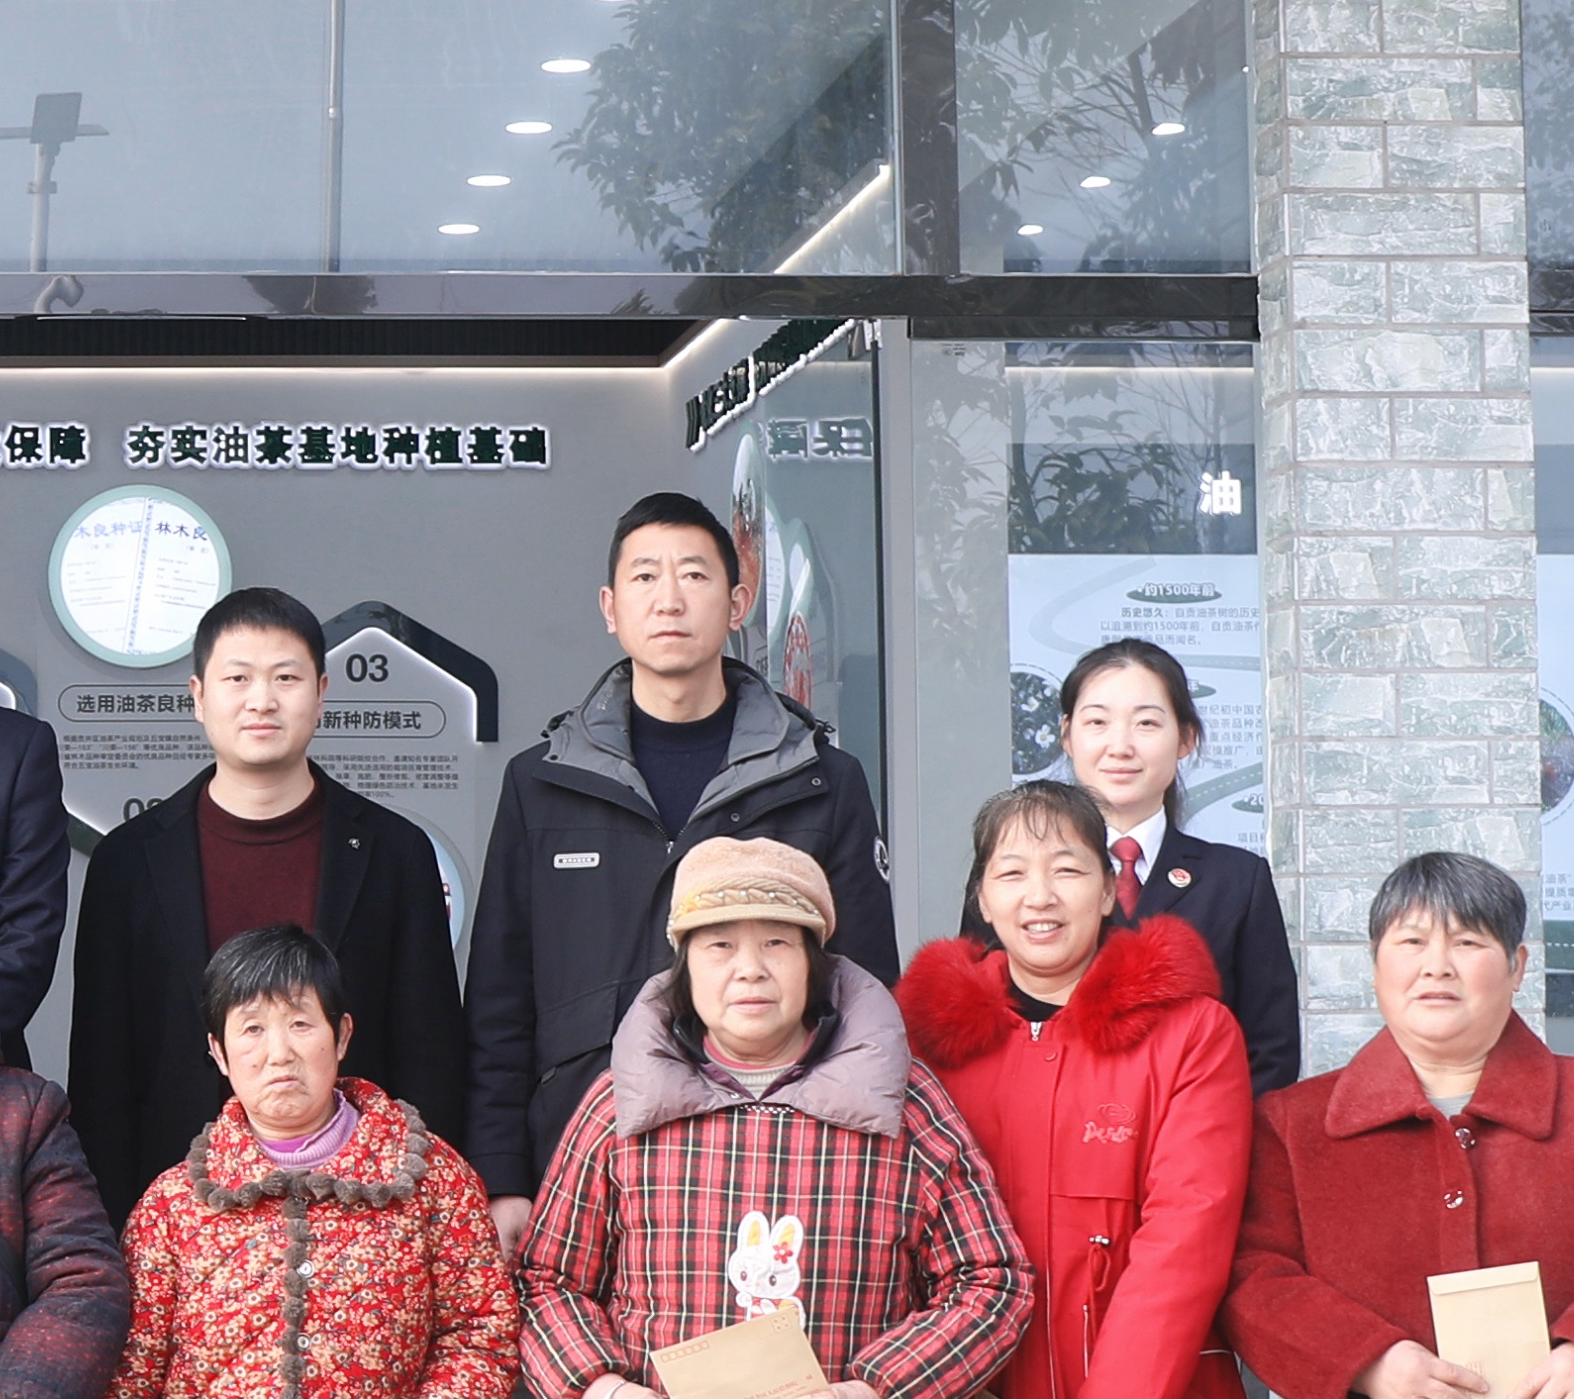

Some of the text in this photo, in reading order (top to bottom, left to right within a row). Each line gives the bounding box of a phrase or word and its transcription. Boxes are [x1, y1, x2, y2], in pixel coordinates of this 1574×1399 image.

[126, 420, 549, 469] 夯实油茶基地种植基础
[1199, 470, 1242, 516] 油
[1143, 583, 1217, 598] 约1500年前
[345, 653, 389, 683] 03
[76, 694, 195, 714] 选用油茶良种
[314, 710, 421, 730] 新种防模式
